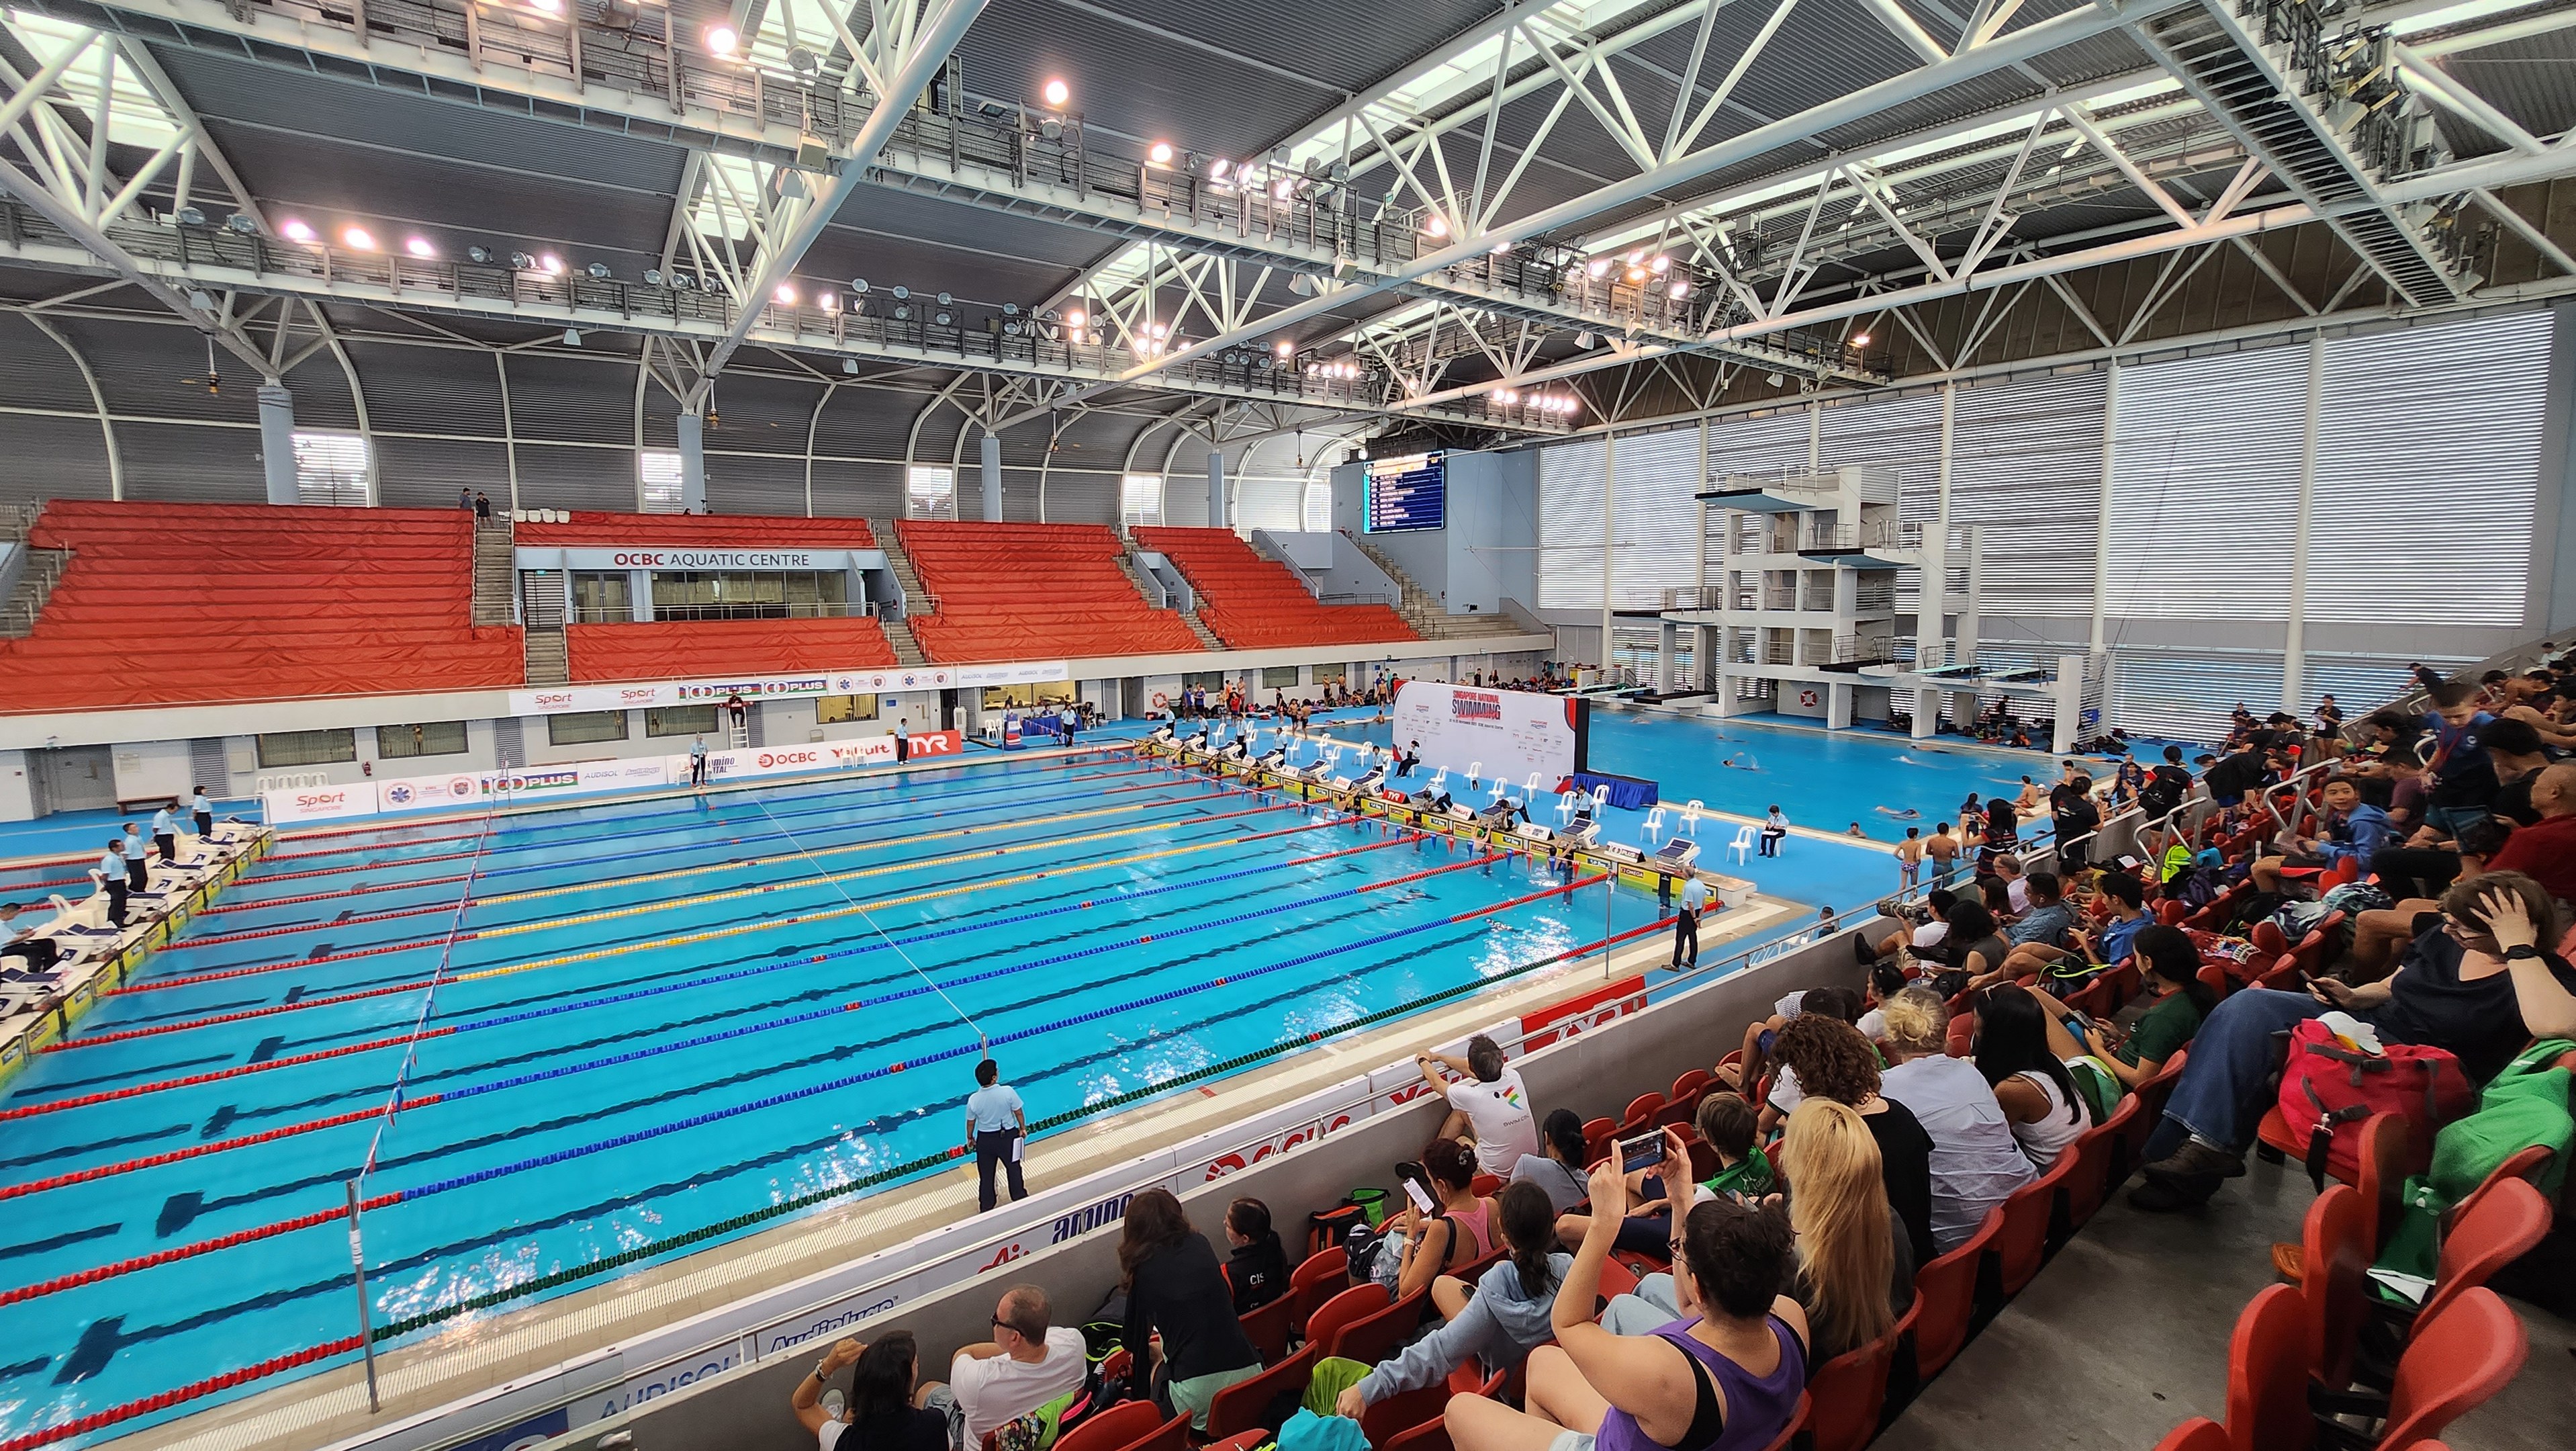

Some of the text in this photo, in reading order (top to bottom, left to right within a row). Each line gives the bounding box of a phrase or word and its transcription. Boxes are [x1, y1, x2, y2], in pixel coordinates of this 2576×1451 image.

[614, 553, 809, 568] OCBC AQUATIC CENTRE
[620, 689, 655, 699] Sport
[759, 680, 823, 697] 100PLUS
[535, 693, 572, 705] Sport
[1453, 690, 1500, 703] SINGAPORE NATIONAL
[1452, 699, 1501, 720] SWIMMING
[908, 735, 950, 754] TYR
[776, 752, 817, 764] OCBC
[584, 771, 618, 779] AUDISOL
[712, 765, 727, 773] ITAL
[484, 775, 574, 795] 100PLUS
[296, 792, 345, 807] Sport
[1387, 791, 1400, 801] TYR
[300, 805, 342, 814] SINGAPORE
[1453, 807, 1469, 816] Yakult
[1607, 845, 1636, 858] 100PLUS
